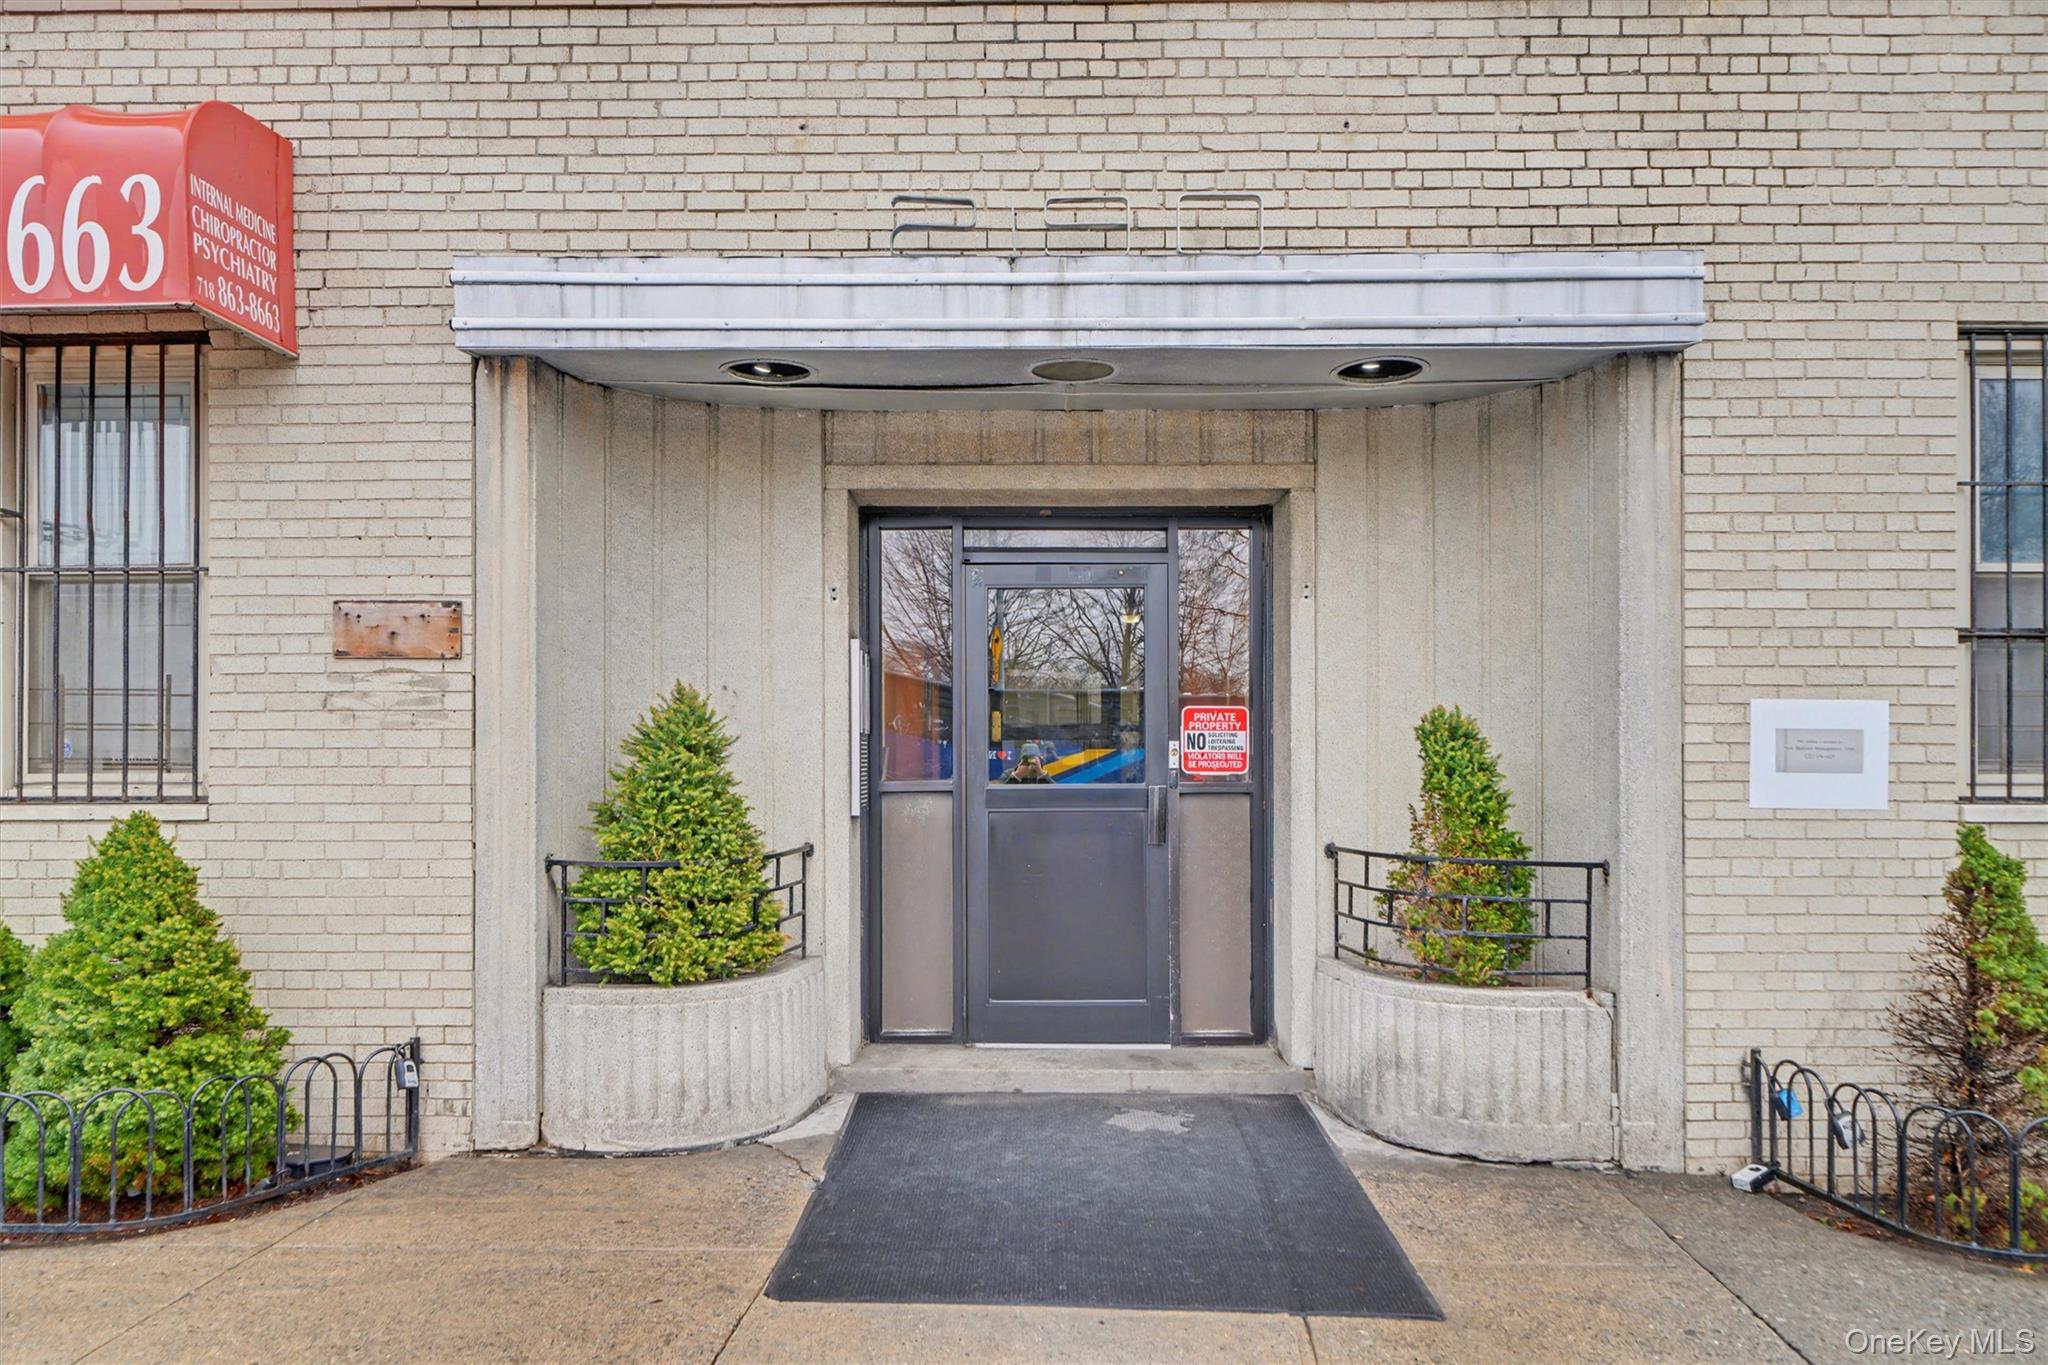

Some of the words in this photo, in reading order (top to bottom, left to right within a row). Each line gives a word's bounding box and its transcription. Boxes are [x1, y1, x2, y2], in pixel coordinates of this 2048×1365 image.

[7, 174, 164, 294] 663
[190, 173, 234, 219] INTERNAL
[236, 202, 276, 244] MEDICINE
[191, 205, 277, 271] CHIROPRACTOR
[193, 232, 278, 295] PSYCHIATRY
[197, 276, 215, 302] 718
[218, 276, 281, 334] 863-8663
[1187, 732, 1206, 750] NO
[1189, 722, 1241, 730] PROPERTY
[1194, 713, 1237, 721] PRIVATE
[1227, 752, 1243, 760] WILL
